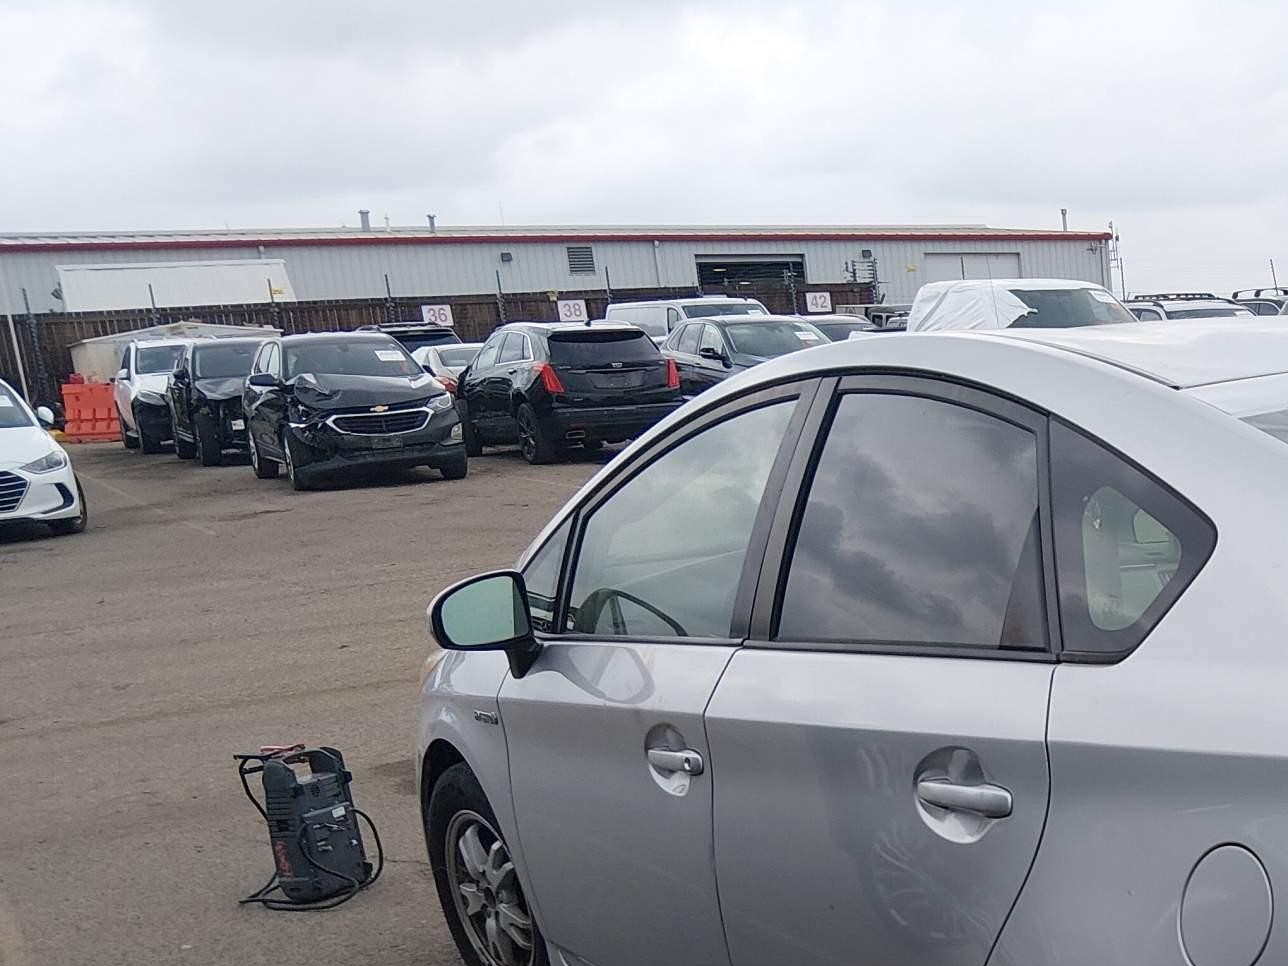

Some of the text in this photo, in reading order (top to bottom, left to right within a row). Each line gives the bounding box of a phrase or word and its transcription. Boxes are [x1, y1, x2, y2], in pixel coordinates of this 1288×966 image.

[811, 294, 828, 308] 42
[427, 307, 448, 323] 36
[563, 303, 582, 317] 38
